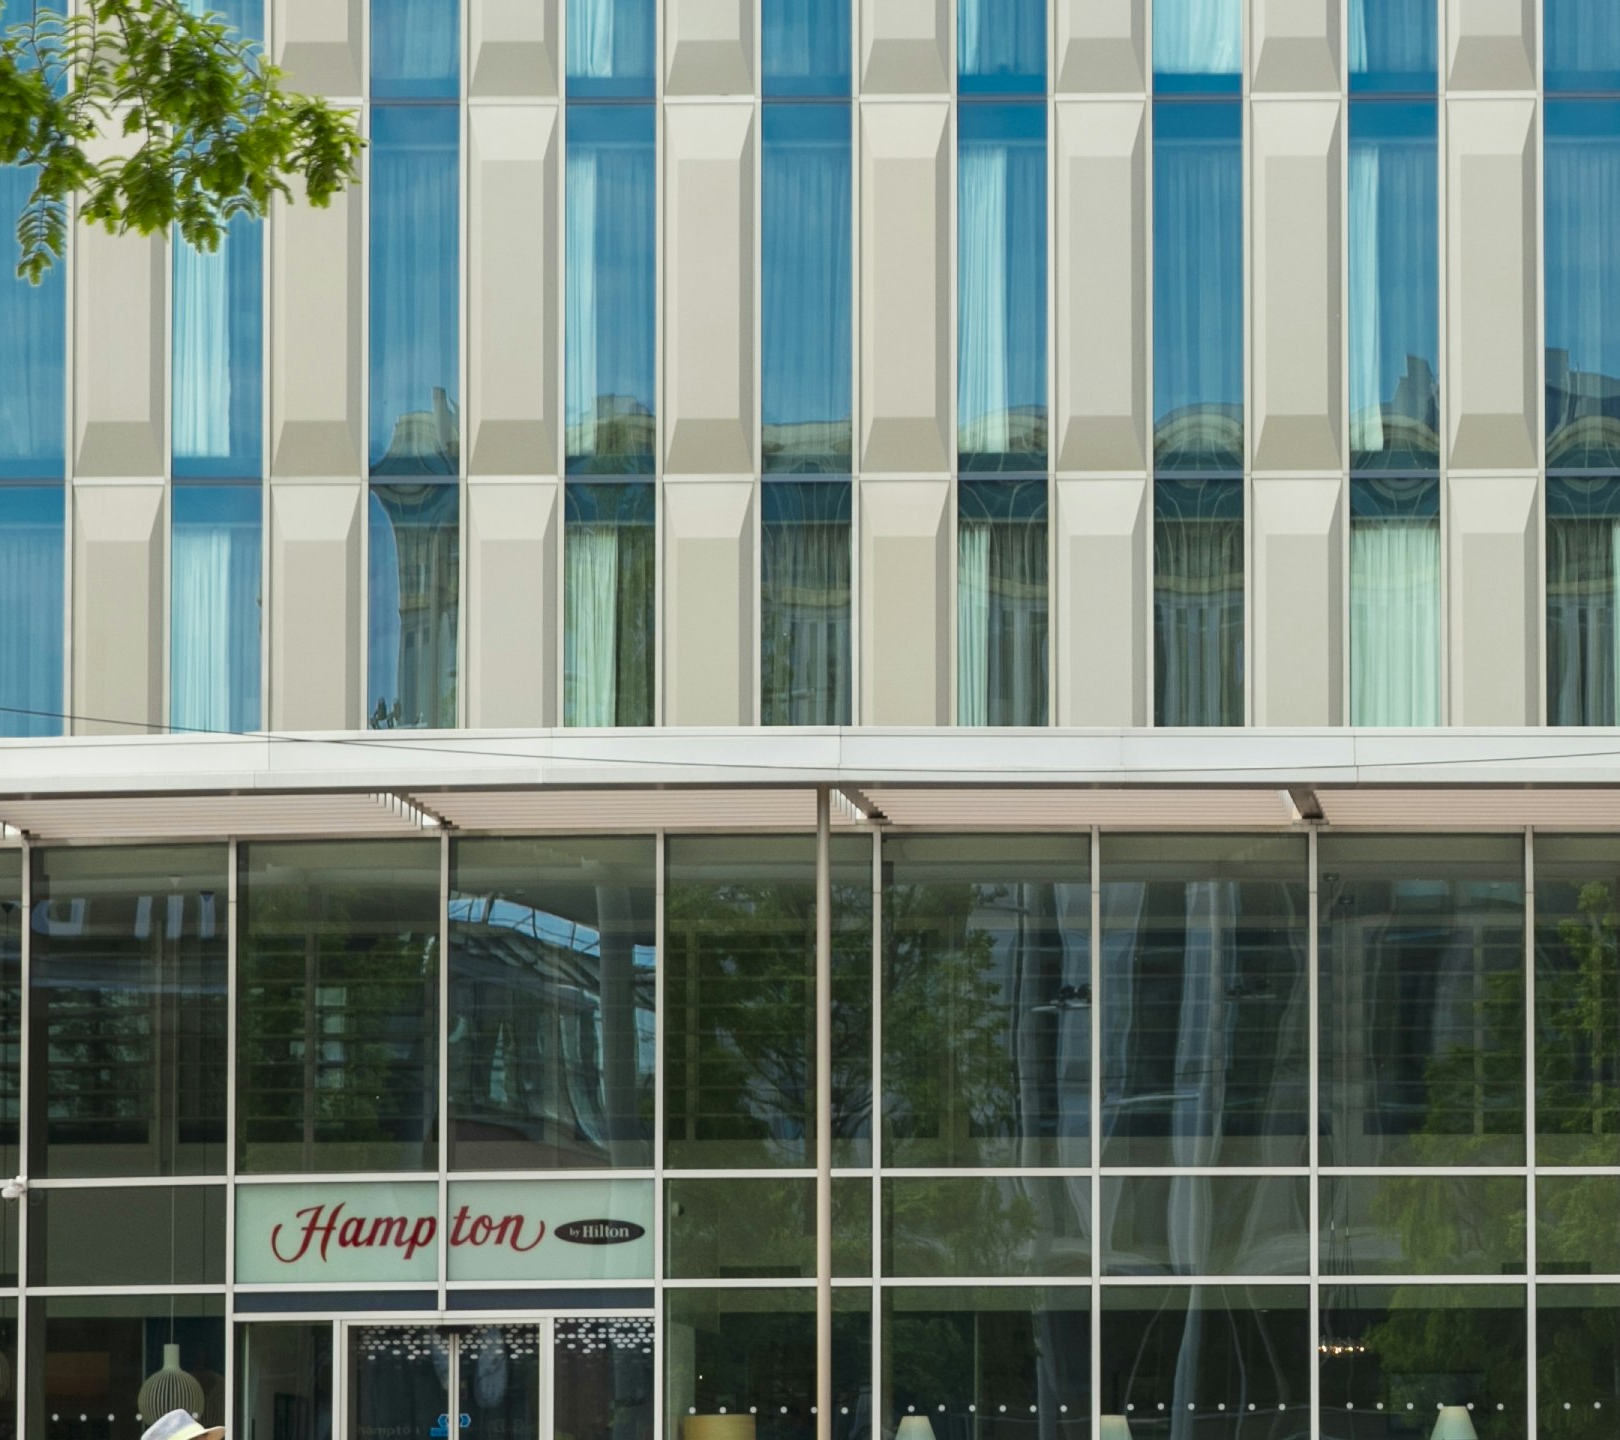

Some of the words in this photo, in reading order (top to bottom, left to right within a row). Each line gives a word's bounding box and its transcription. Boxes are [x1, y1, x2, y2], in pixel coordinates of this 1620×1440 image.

[272, 1202, 544, 1262] Hampton
[569, 1227, 579, 1237] by
[583, 1224, 629, 1238] Hilton
